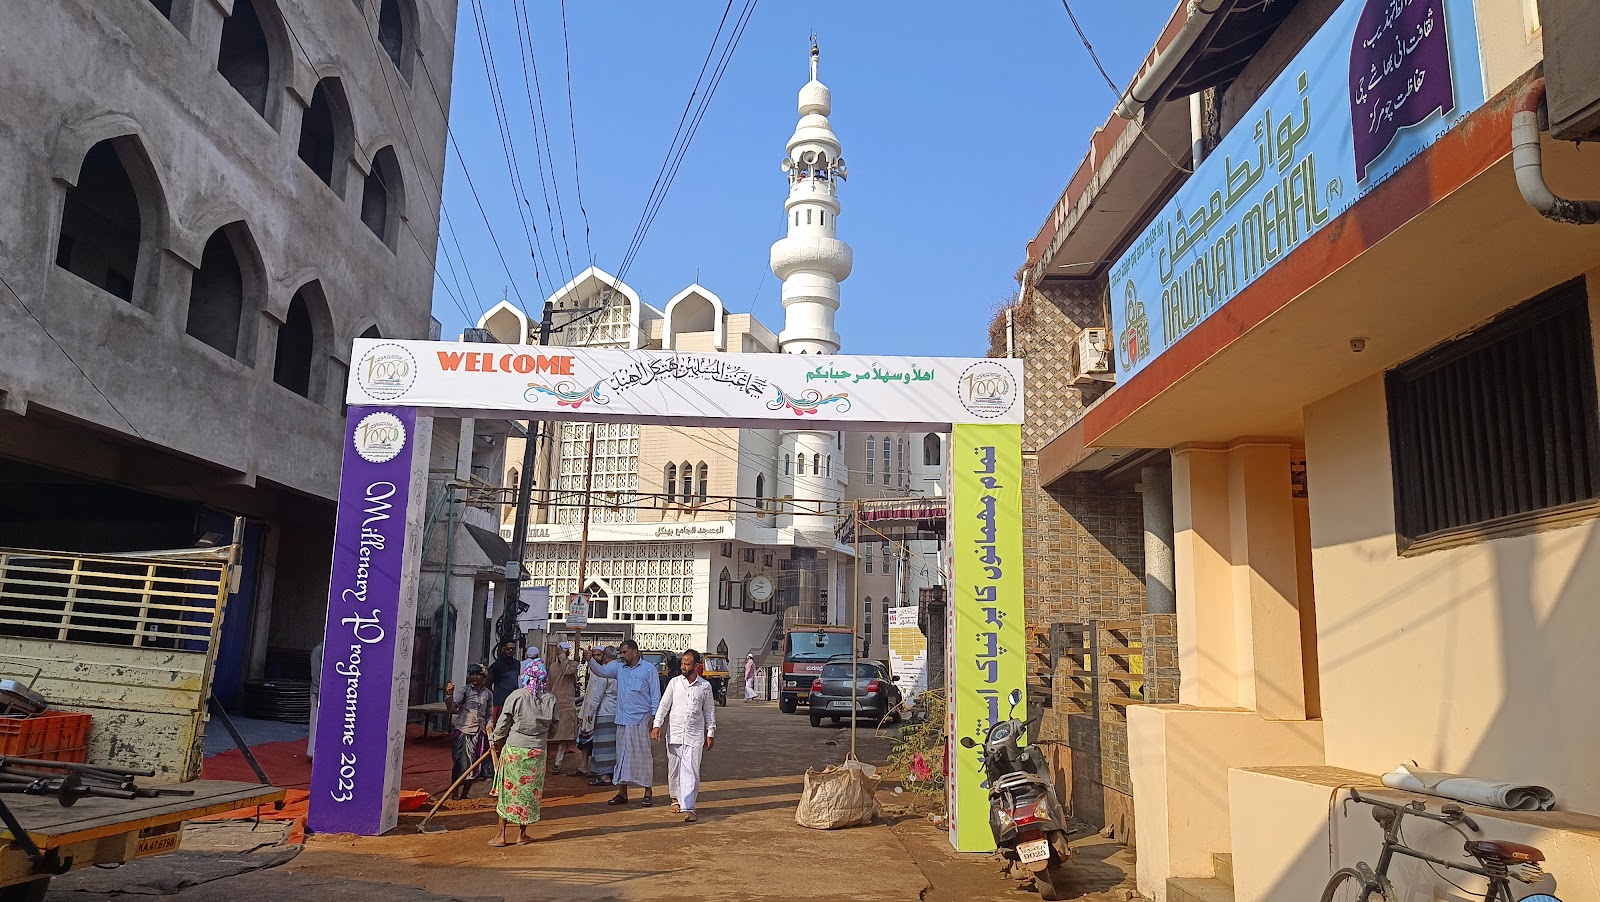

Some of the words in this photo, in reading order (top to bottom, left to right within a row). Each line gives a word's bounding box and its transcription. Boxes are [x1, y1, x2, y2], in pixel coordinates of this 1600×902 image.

[1158, 188, 1224, 286] محفل
[1161, 222, 1238, 348] NAWAYAT
[1241, 151, 1329, 283] MEHFIL
[437, 351, 575, 376] WELCOME
[342, 481, 397, 602] Millenary
[335, 608, 386, 746] Programme
[330, 752, 357, 802] 2023
